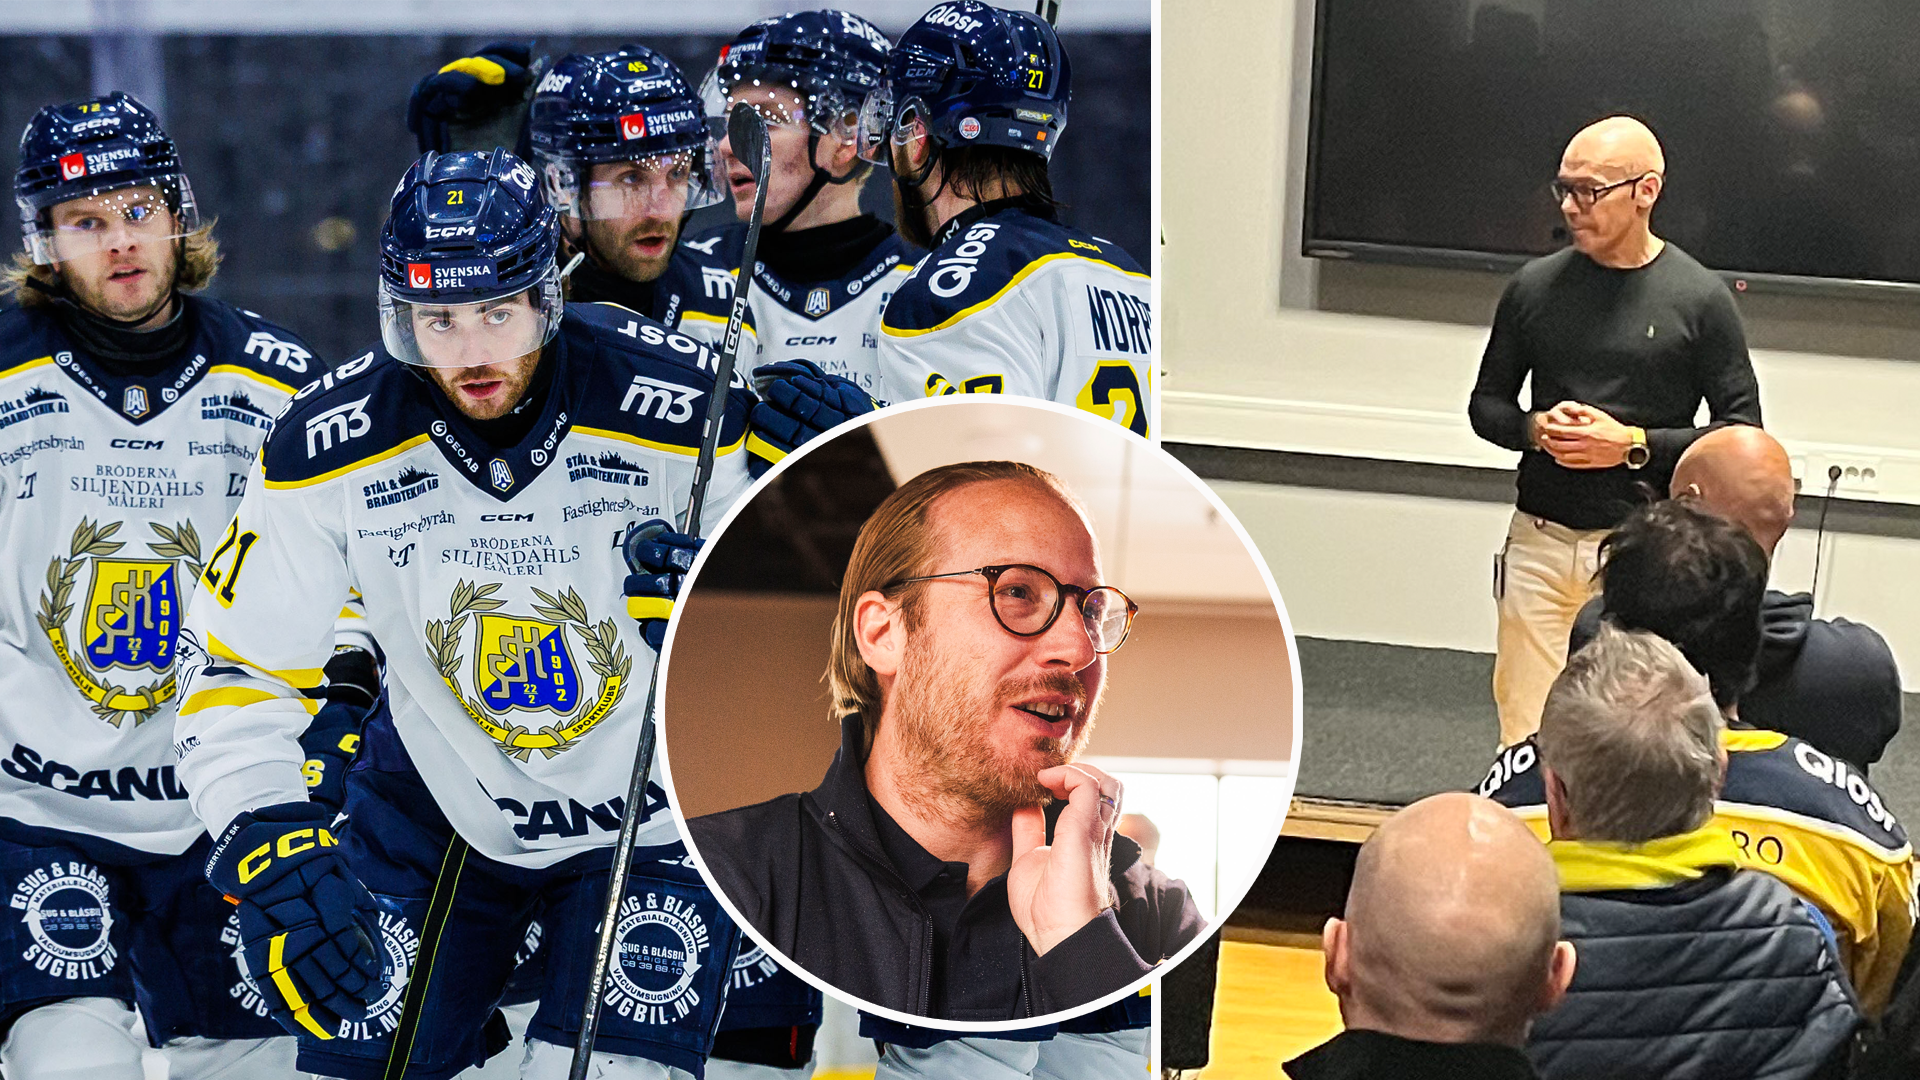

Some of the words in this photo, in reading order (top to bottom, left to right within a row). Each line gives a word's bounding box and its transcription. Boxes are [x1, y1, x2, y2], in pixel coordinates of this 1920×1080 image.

[925, 5, 983, 33] Qlosr
[628, 61, 649, 73] 45
[905, 68, 937, 78] CCM
[536, 68, 572, 93] losr
[628, 79, 672, 94] CCM
[1028, 69, 1044, 89] 27
[78, 103, 102, 114] 72
[72, 117, 121, 133] CCM
[646, 110, 696, 126] SVENSKA
[649, 124, 676, 137] SPEL
[87, 148, 141, 165] SVENSKA
[89, 162, 119, 175] SPEL
[447, 190, 464, 205] 21
[425, 226, 477, 239] CCM
[929, 223, 1001, 298] Qlosr
[434, 265, 491, 278] SVENSKA
[436, 278, 465, 289] SPEL
[727, 301, 744, 351] CCM
[785, 336, 838, 346] CCM
[244, 332, 312, 373] m3
[0, 400, 16, 415] TÅL
[619, 374, 705, 424] m3
[305, 393, 372, 460] m3
[110, 438, 164, 450] CCM
[543, 426, 557, 450] GE
[565, 452, 589, 469] STÅL
[589, 455, 597, 466] &
[95, 464, 177, 479] BRÖDERNA
[569, 466, 631, 485] BRANDTEKNIK
[633, 475, 649, 487] AB
[70, 476, 205, 498] SILJENDAHLS
[363, 480, 389, 497] STÅL
[389, 478, 398, 490] &
[107, 494, 164, 509] MÅLERI
[562, 497, 660, 523] Fastighetsbyrån
[357, 510, 456, 541] Fastighetbyrån
[480, 512, 535, 522] CCM
[469, 534, 554, 551] BRÖDERNA
[200, 514, 260, 609] 21
[440, 545, 581, 569] SILJENDAHLS
[128, 638, 142, 649] 22
[523, 683, 537, 693] 22
[572, 684, 617, 734] SPORTKLUBB
[1794, 742, 1896, 831] Qlosr
[492, 779, 673, 841] CANIA
[229, 823, 241, 836] SK
[17, 867, 50, 896] SUG
[51, 861, 65, 877] &
[40, 909, 58, 918] SUG
[646, 892, 658, 909] &
[663, 895, 710, 953] BLÅSBIL
[618, 914, 695, 955] MATERIALBLÅSNING
[621, 942, 640, 953] SUG
[642, 945, 649, 954] &
[651, 946, 684, 961] BLÅSBIL
[622, 953, 668, 966] SVERIGE
[639, 962, 653, 970] 39
[613, 968, 683, 1001] VACUUMSUGNING
